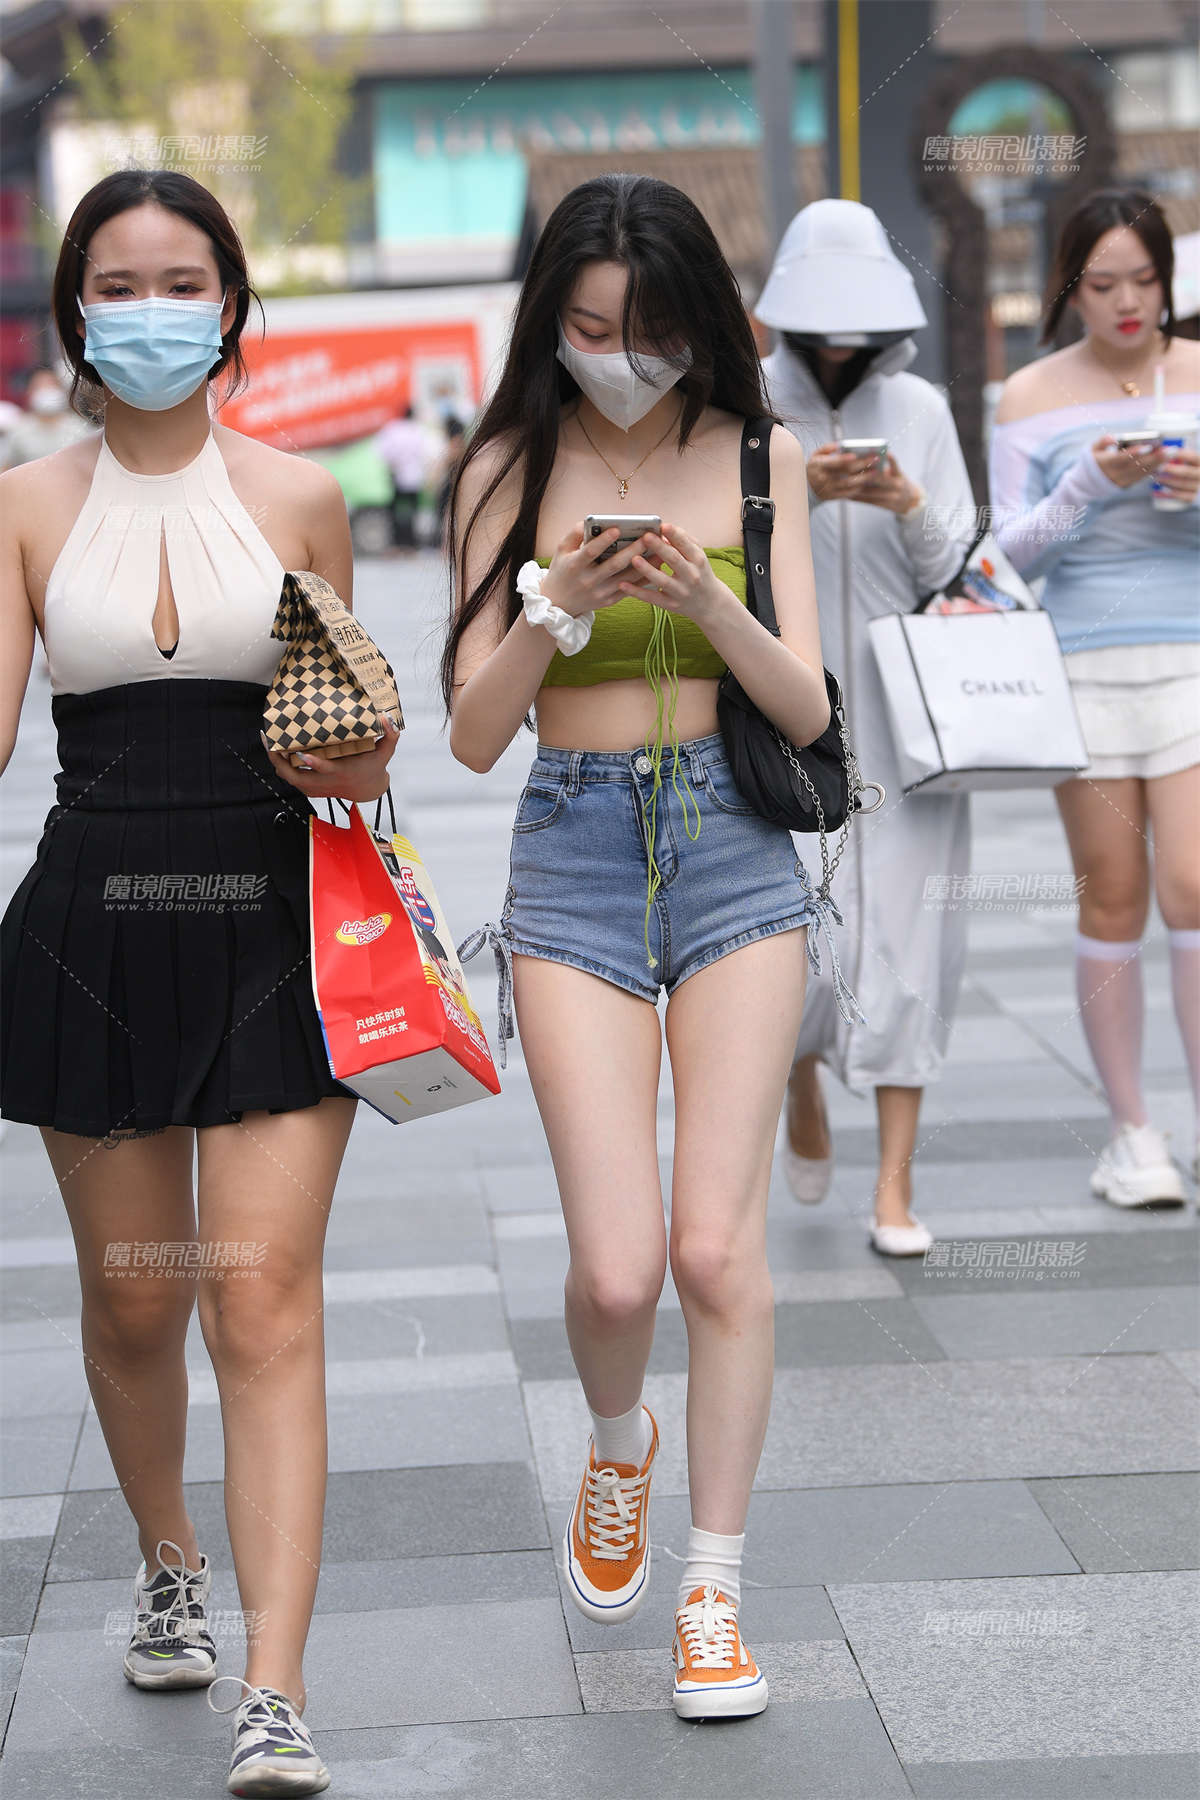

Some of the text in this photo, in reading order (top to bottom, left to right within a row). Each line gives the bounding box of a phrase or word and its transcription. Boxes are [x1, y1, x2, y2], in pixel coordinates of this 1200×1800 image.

[960, 679, 1045, 696] CHANEL
[356, 1006, 405, 1031] 凡快乐时刻
